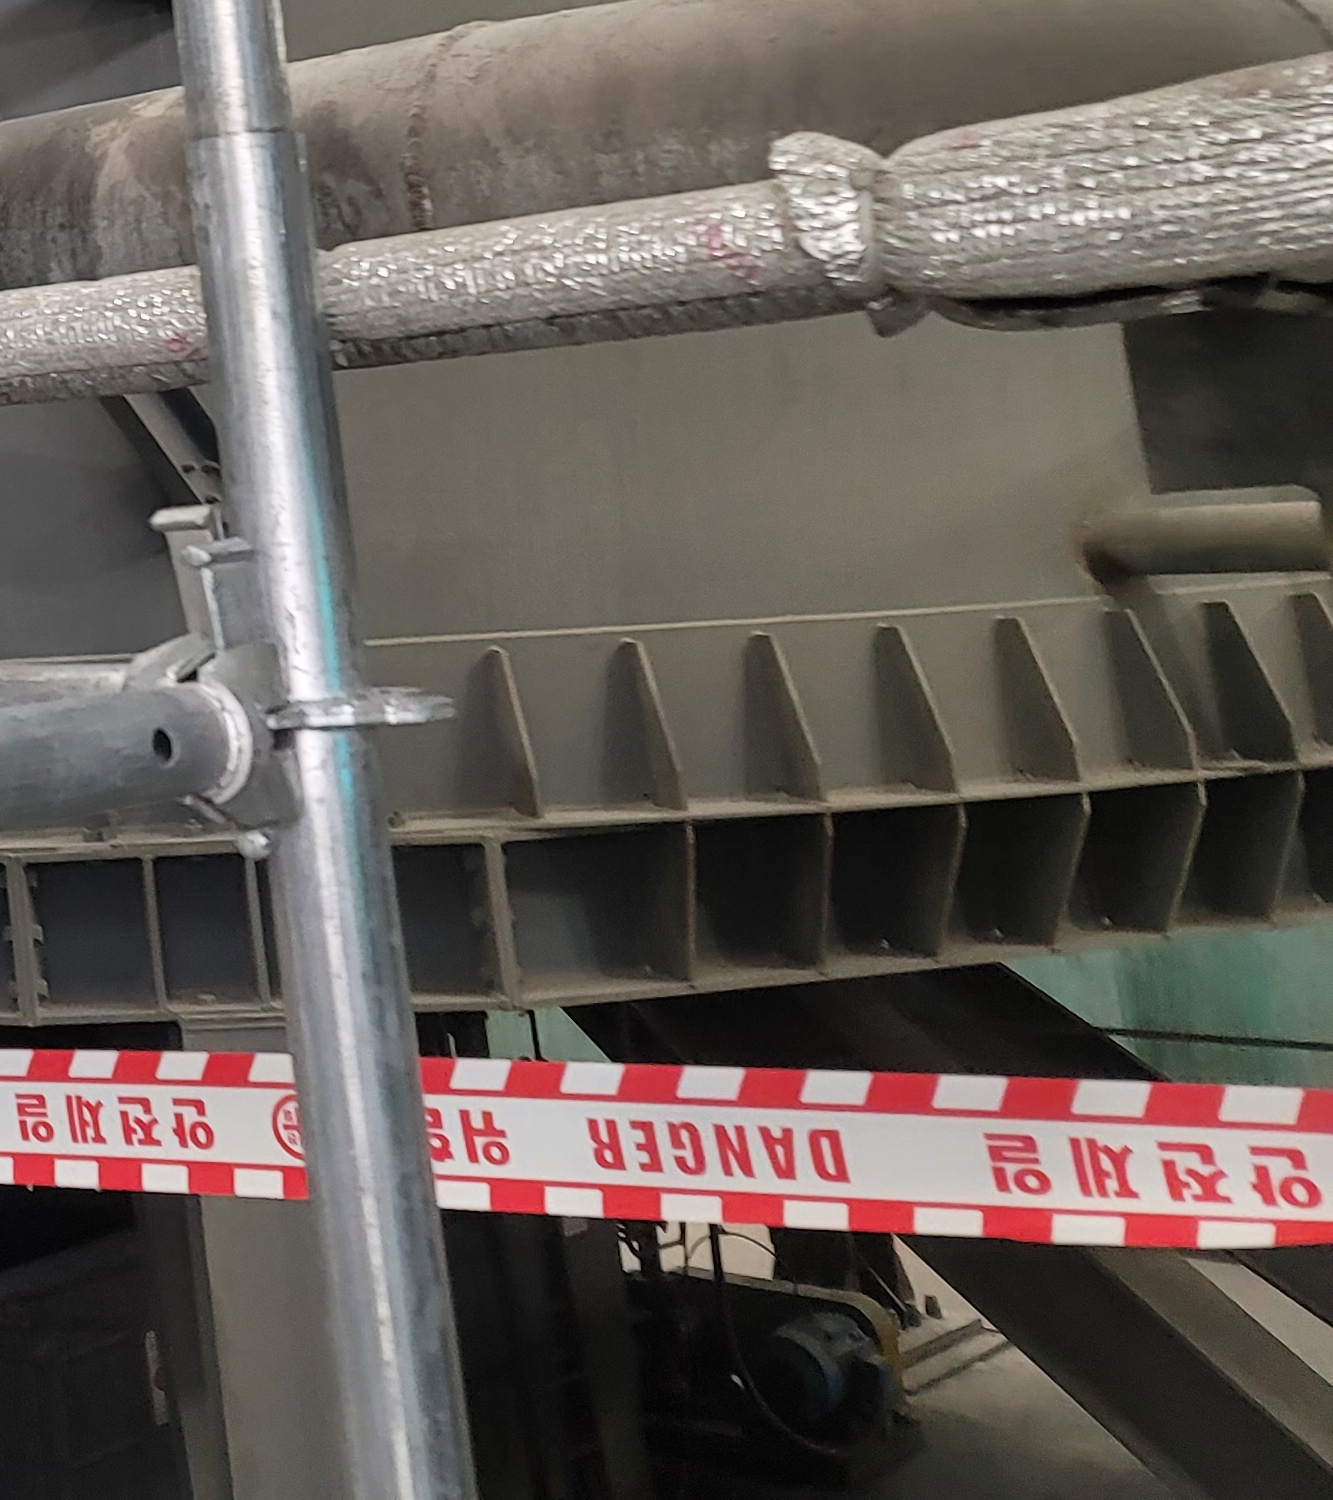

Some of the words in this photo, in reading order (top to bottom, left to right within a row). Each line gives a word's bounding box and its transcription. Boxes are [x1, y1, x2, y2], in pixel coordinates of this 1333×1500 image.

[15, 1092, 215, 1150] 안전제일
[586, 1117, 851, 1184] DANGER
[984, 1132, 1323, 1210] 안전제일
